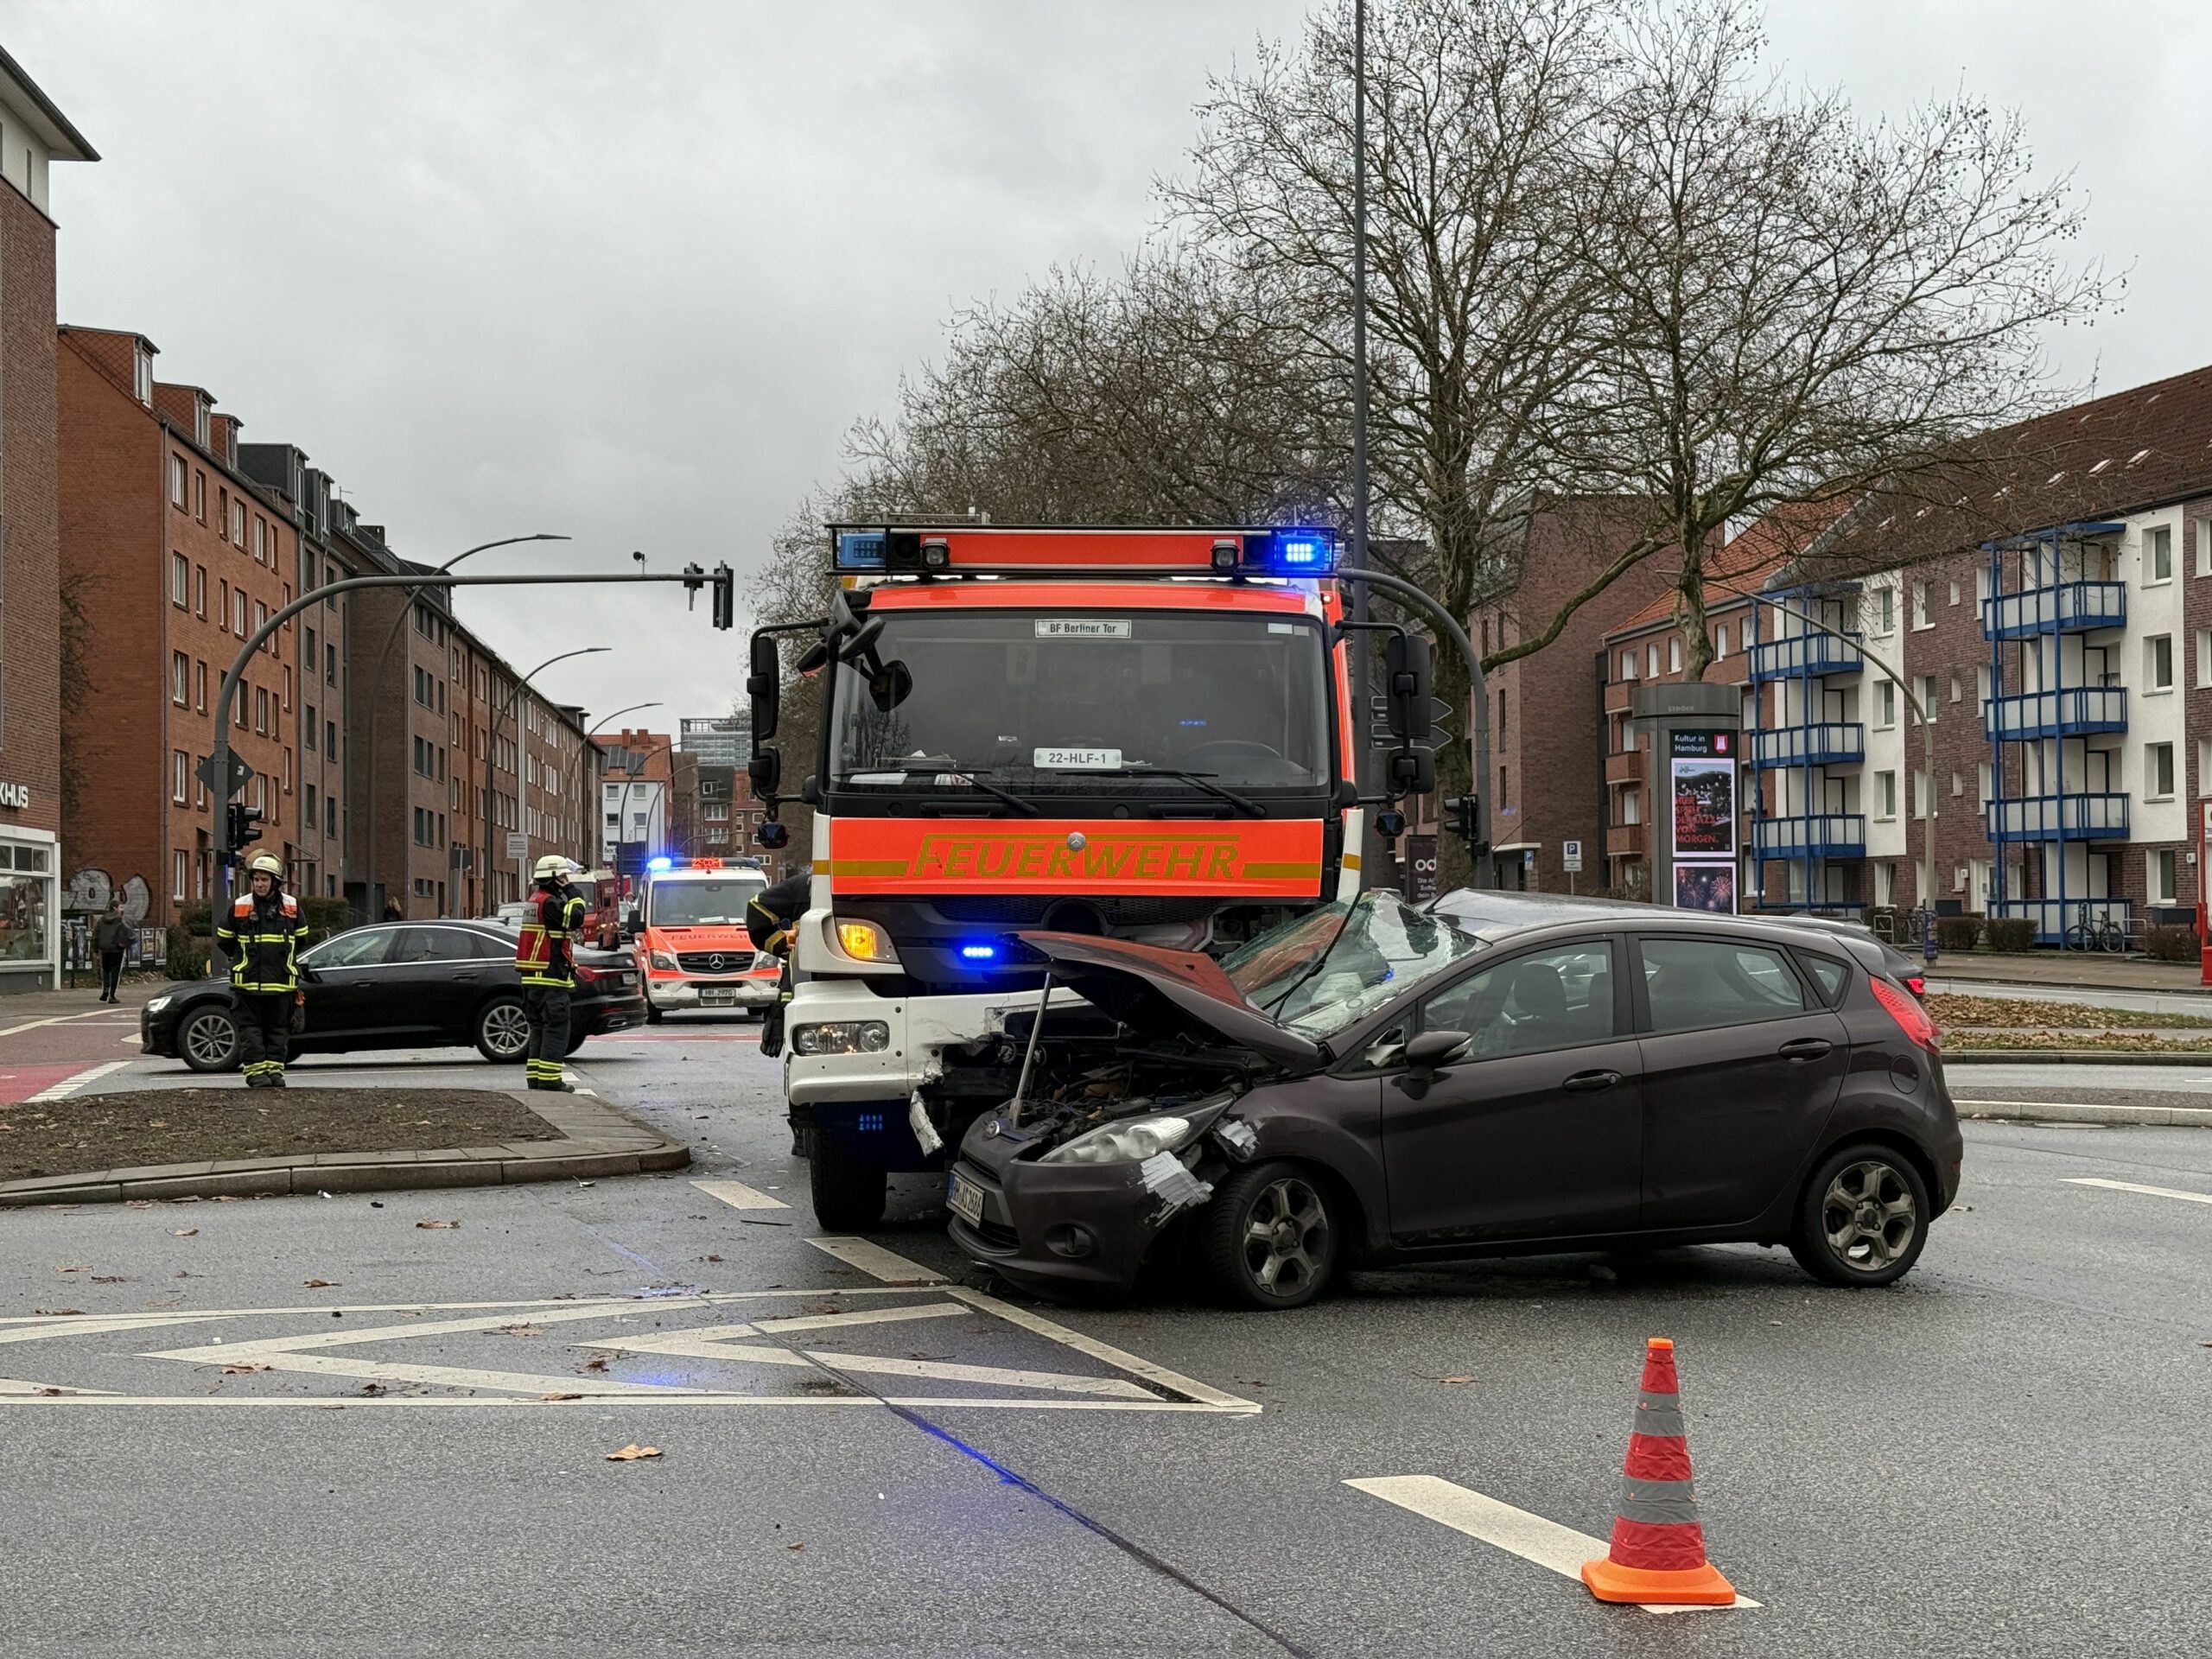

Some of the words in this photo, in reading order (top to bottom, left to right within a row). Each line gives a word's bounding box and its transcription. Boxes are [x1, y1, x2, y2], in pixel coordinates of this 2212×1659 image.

[1050, 623, 1061, 632] BF
[1065, 623, 1100, 633] Berliner
[1103, 623, 1116, 633] Tor
[1675, 744, 1707, 753] Hamburg
[1048, 753, 1106, 764] 22-HLF-1
[1569, 844, 1575, 853] P
[912, 834, 1240, 879] FEUERWEHR
